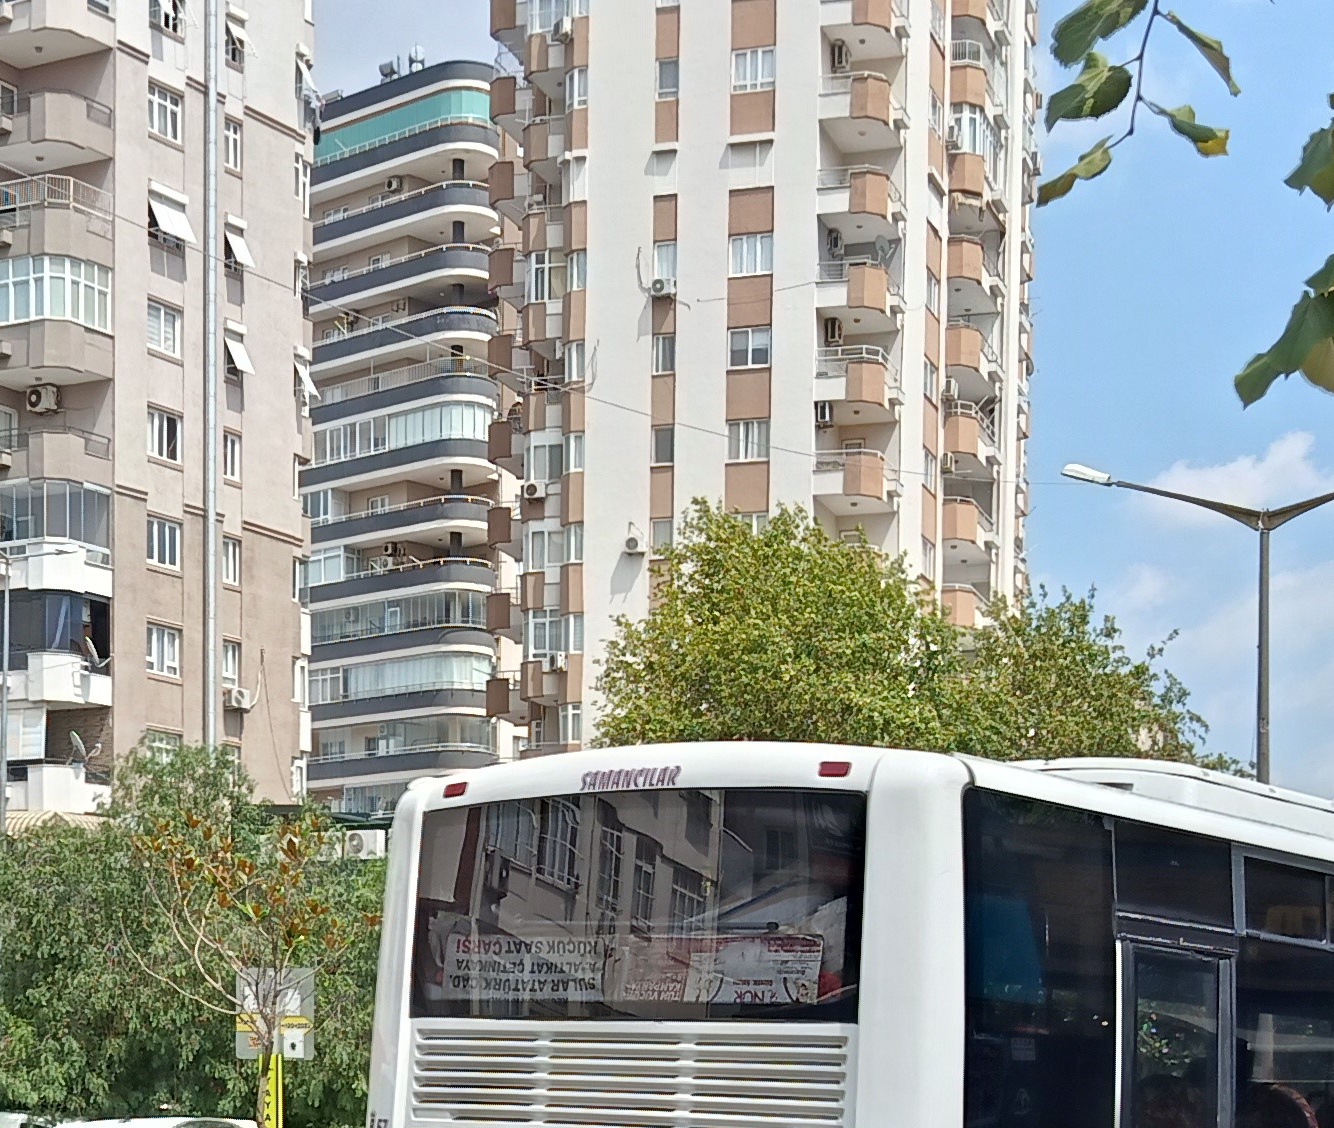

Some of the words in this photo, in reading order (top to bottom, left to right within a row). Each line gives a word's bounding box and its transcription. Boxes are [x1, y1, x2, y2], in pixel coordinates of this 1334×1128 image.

[505, 941, 543, 955] SAAT
[545, 938, 598, 956] KÜÇÜK
[484, 977, 548, 993] ATATÜRK
[550, 977, 596, 992] SULAR
